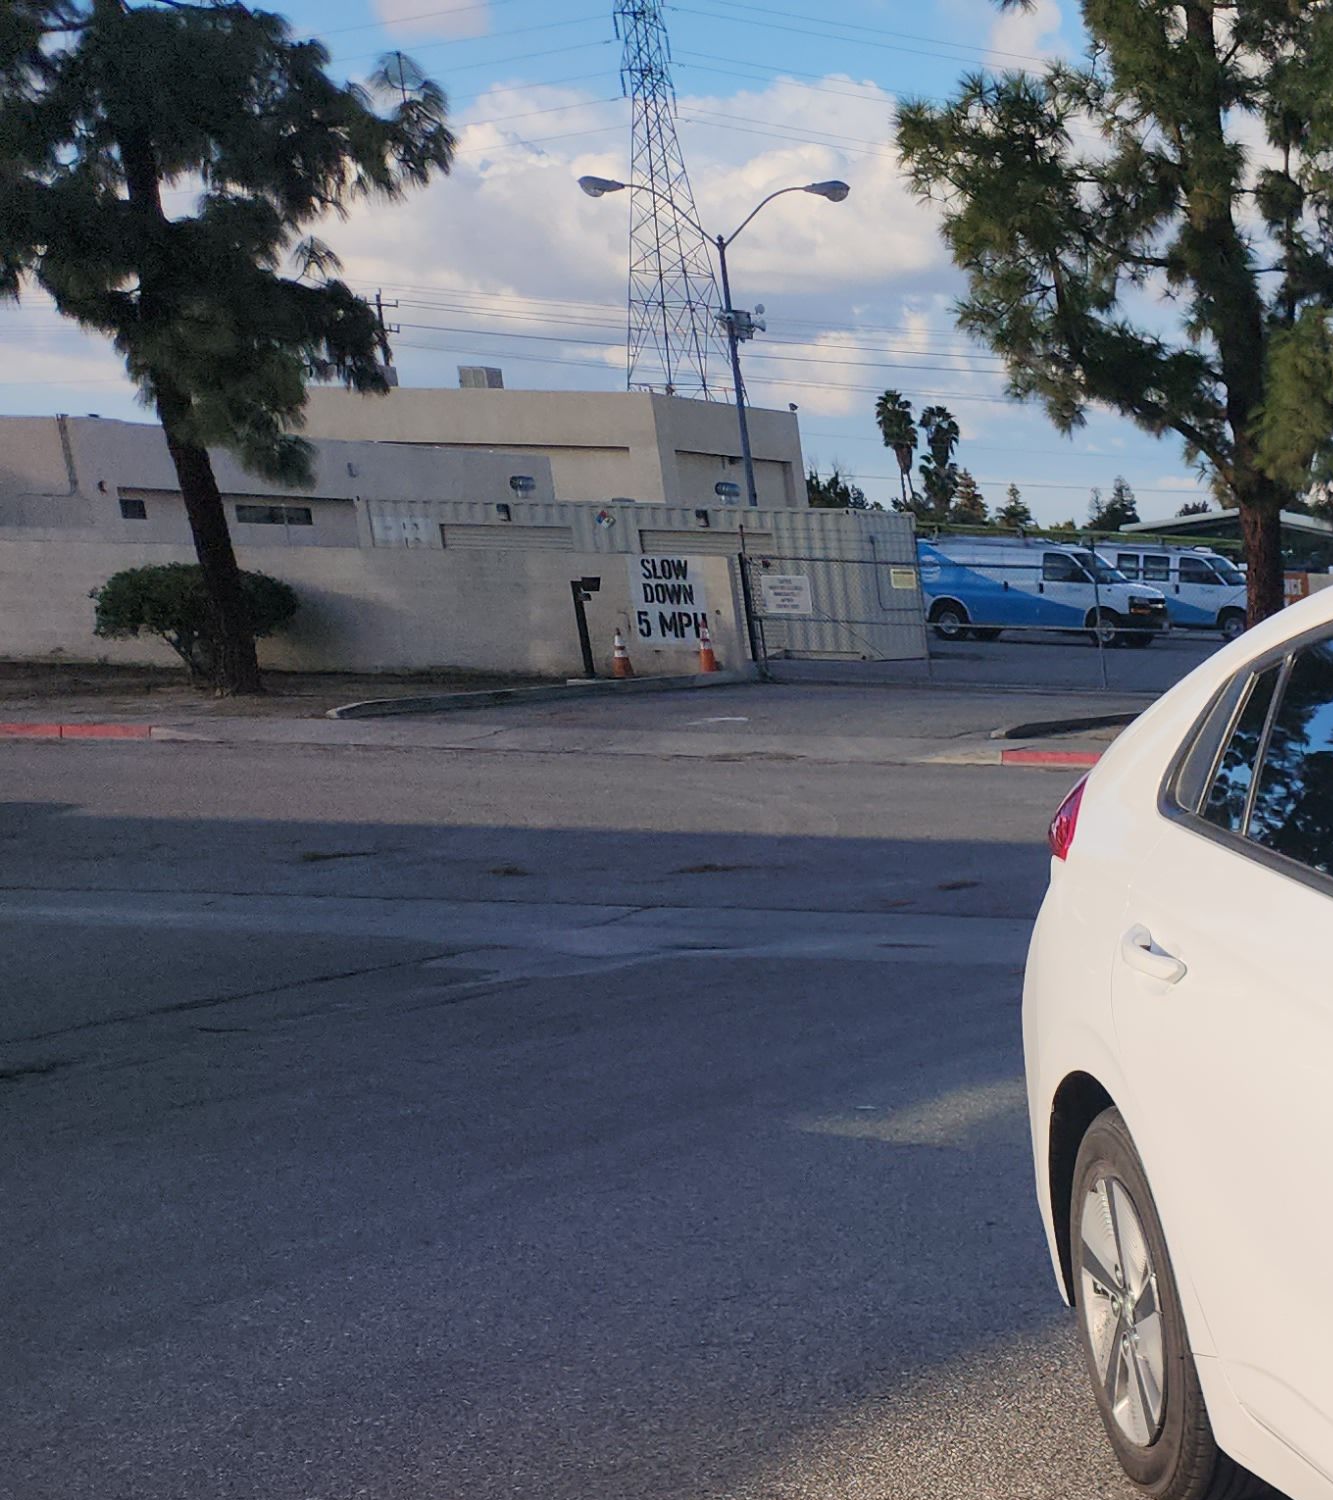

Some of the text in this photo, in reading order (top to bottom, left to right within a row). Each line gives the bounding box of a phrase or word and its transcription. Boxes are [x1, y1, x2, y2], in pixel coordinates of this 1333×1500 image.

[640, 558, 688, 581] SLOW
[641, 582, 695, 606] DOWN
[636, 610, 709, 639] 5 MPH
